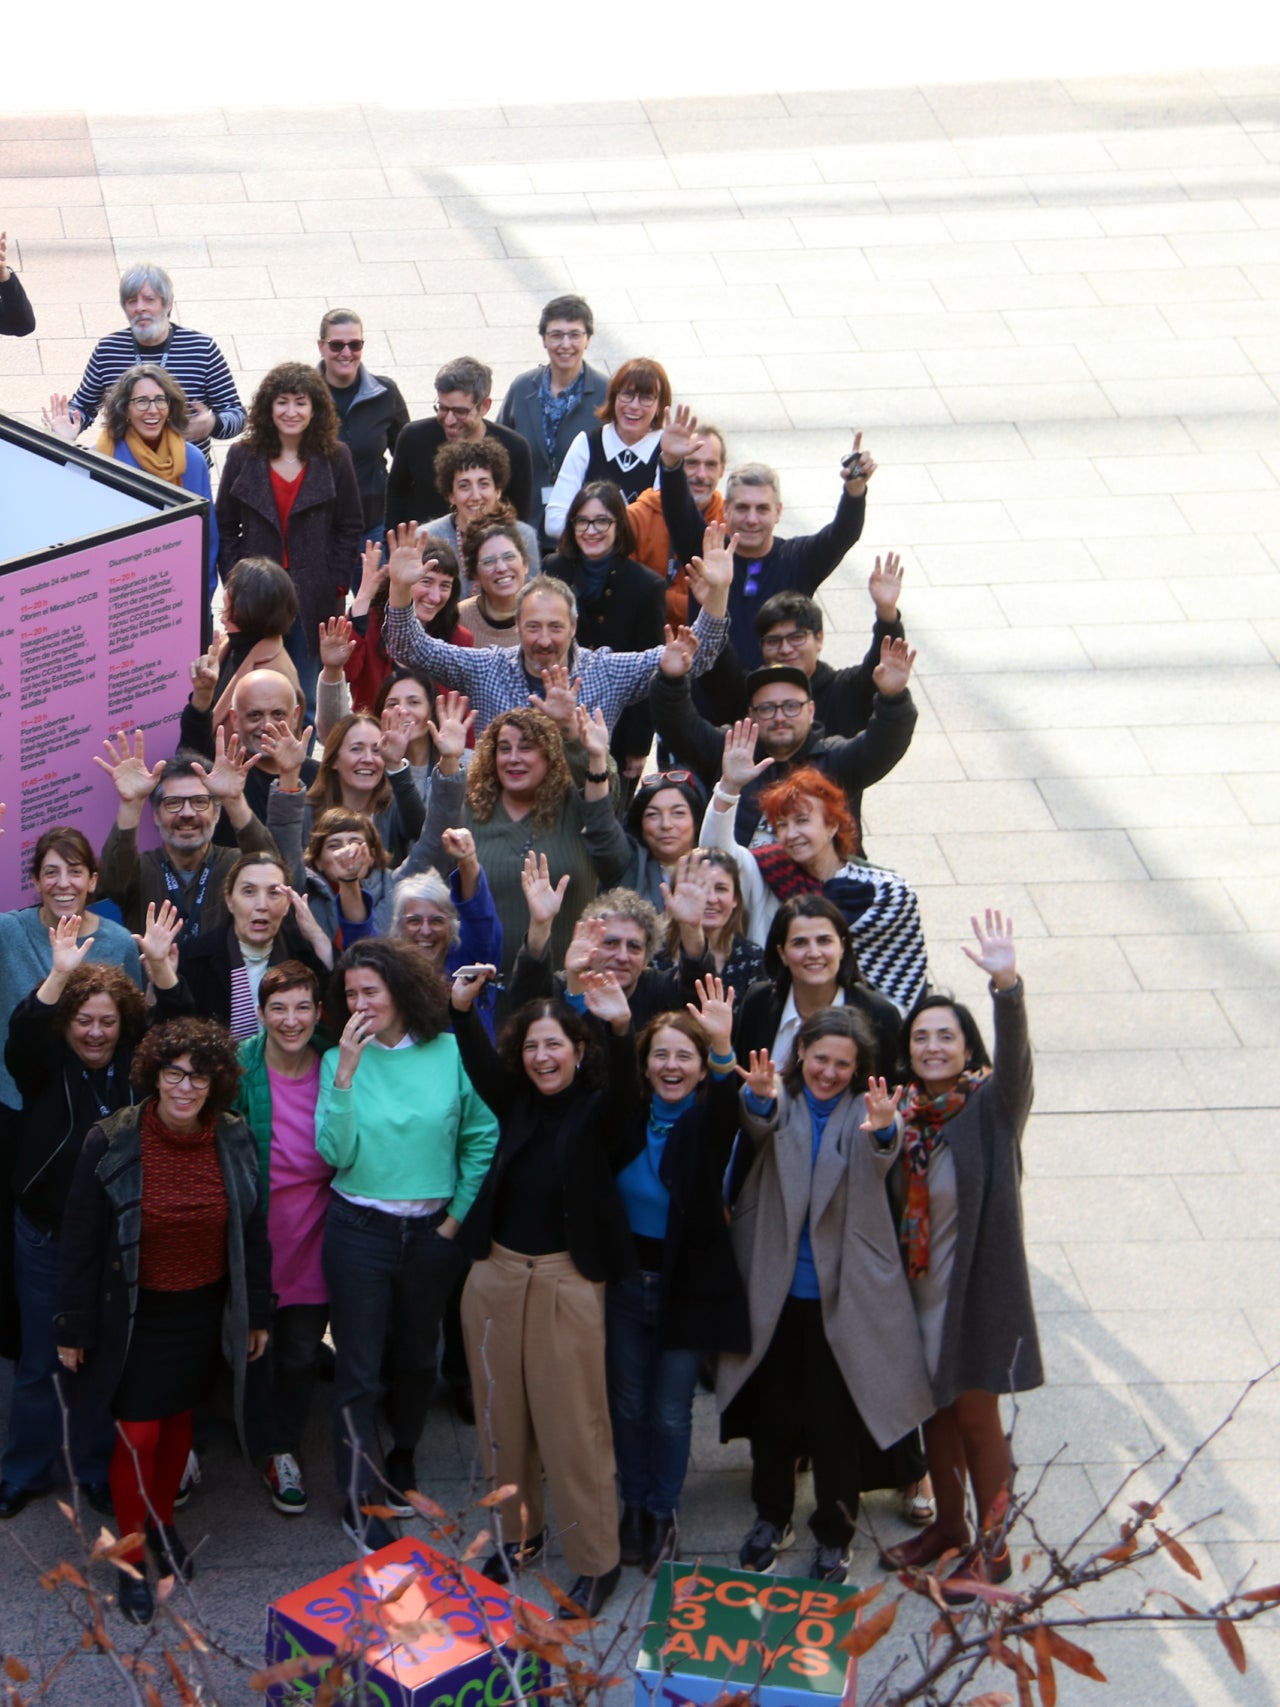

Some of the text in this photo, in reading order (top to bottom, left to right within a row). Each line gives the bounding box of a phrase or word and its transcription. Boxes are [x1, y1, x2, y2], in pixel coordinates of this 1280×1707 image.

[673, 1575, 839, 1618] CCCB
[671, 1602, 835, 1648] 3 0
[662, 1631, 831, 1676] ANYS
